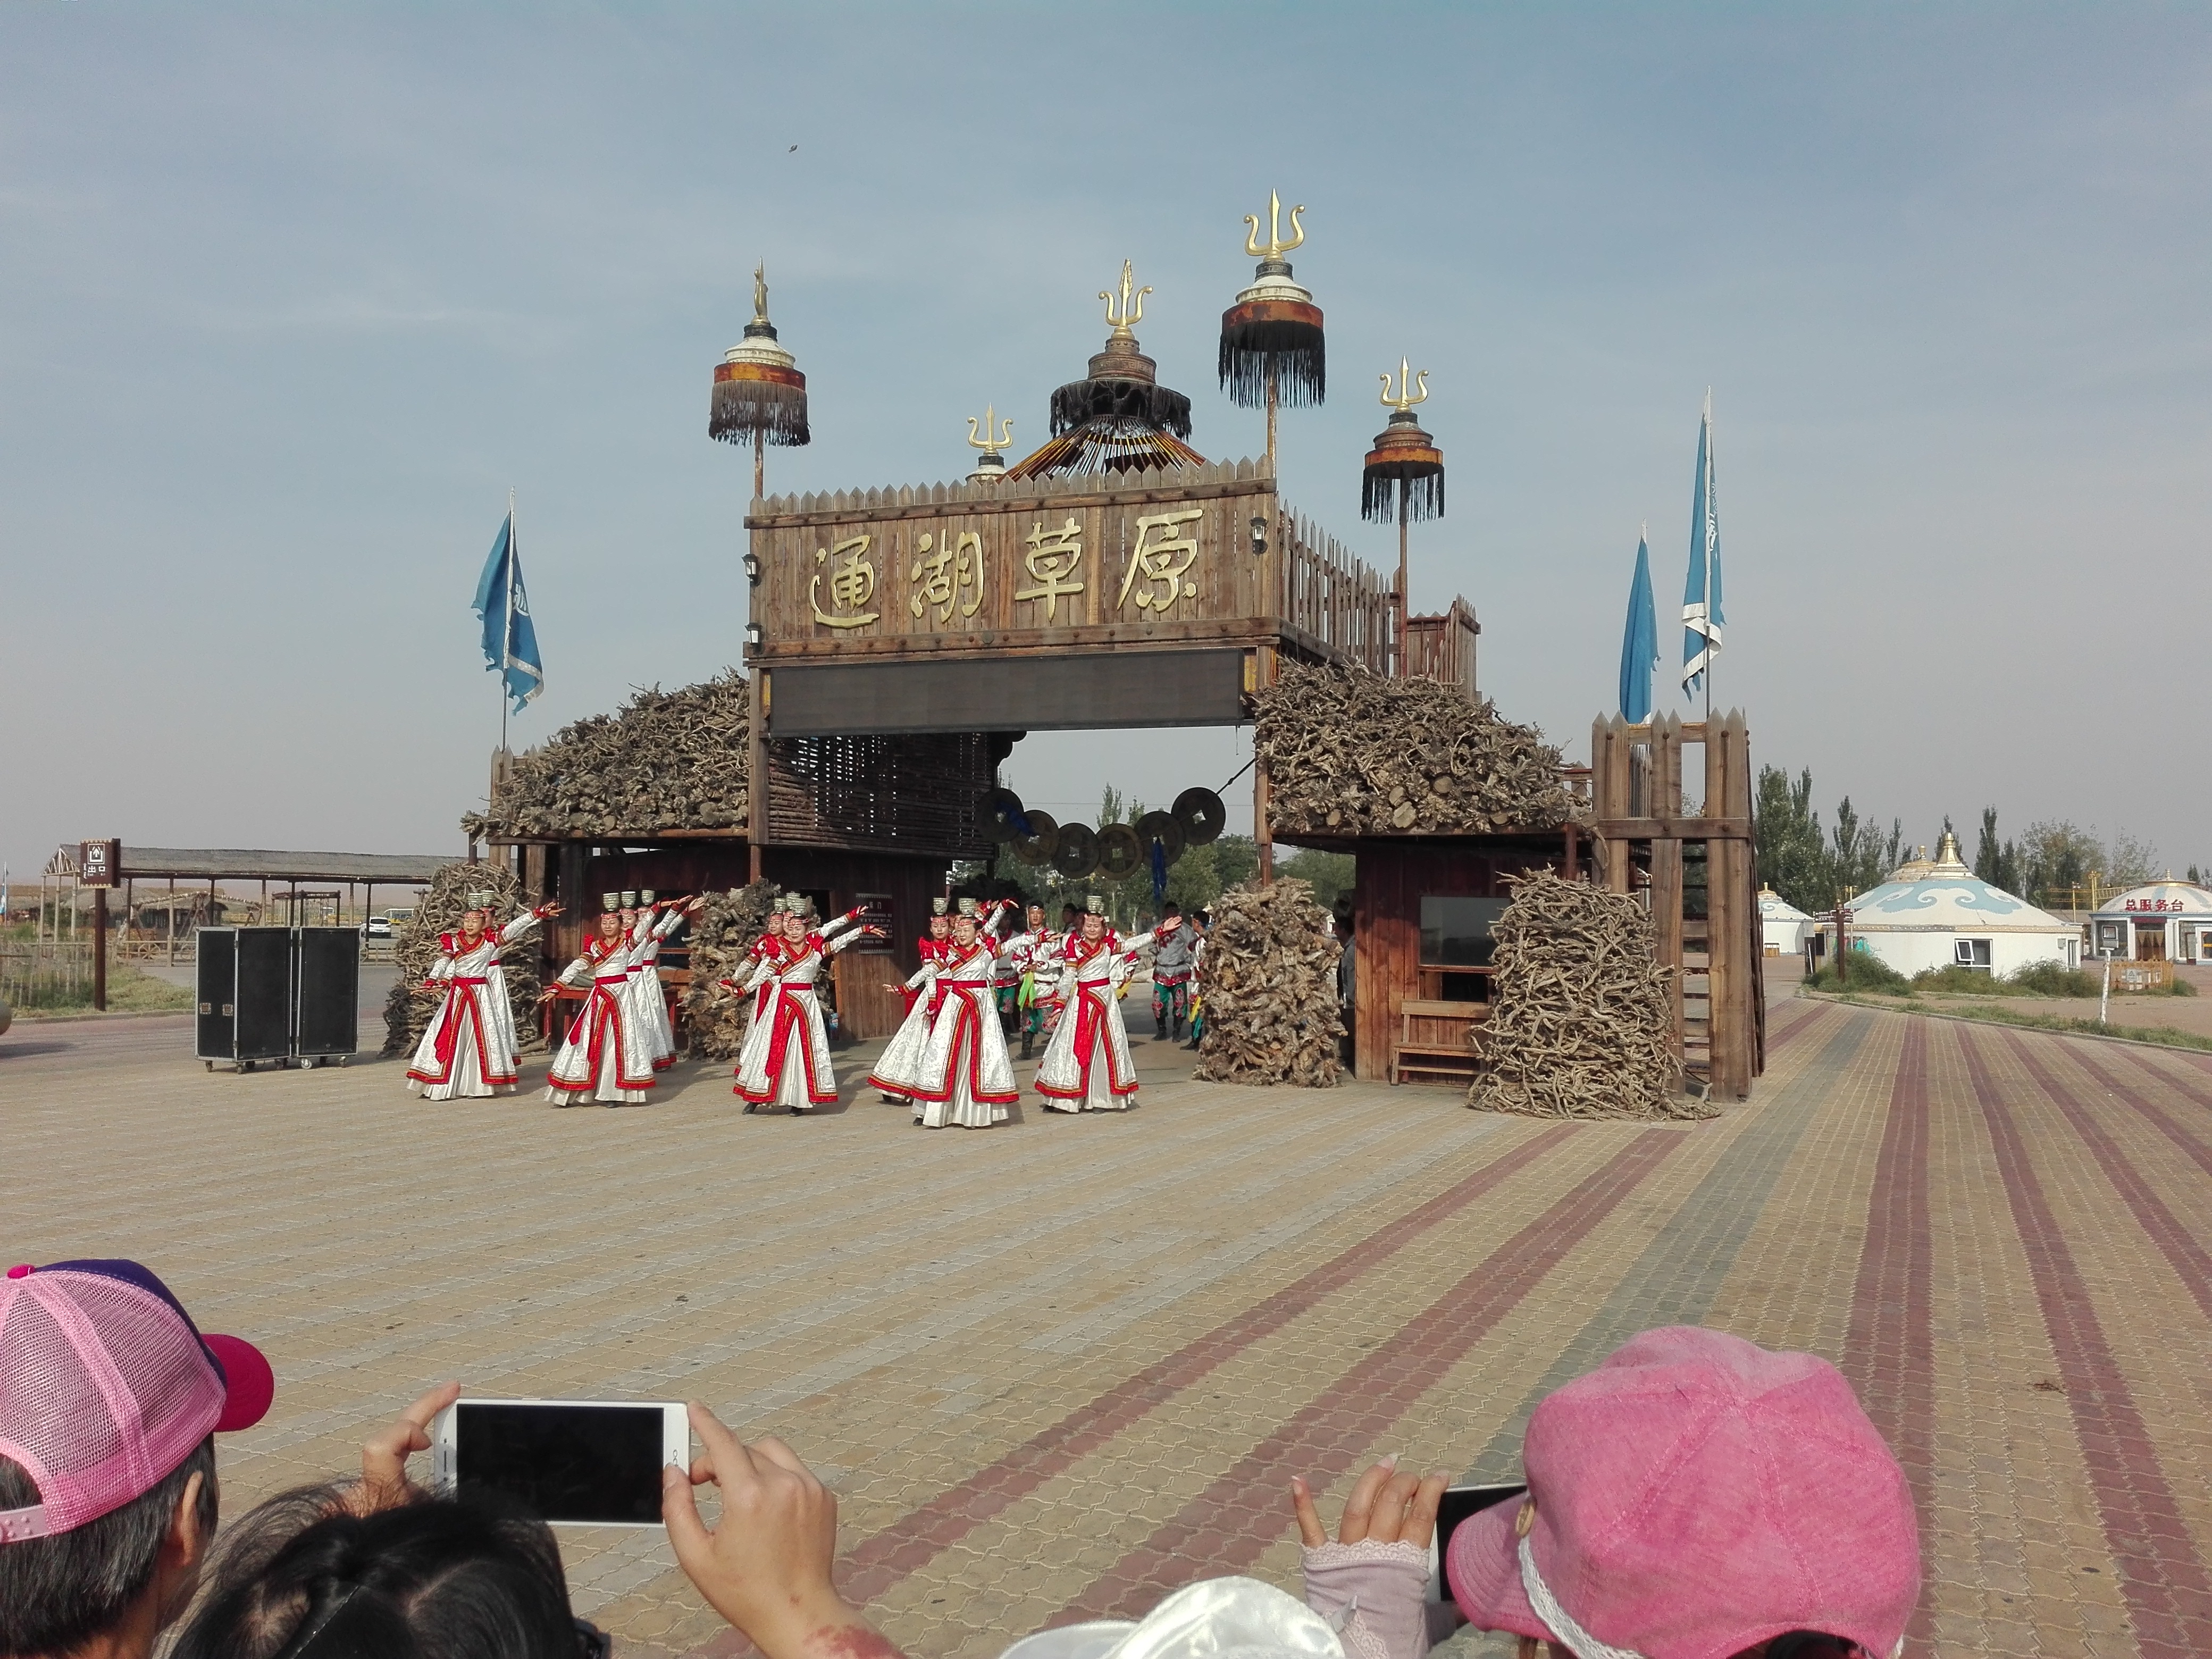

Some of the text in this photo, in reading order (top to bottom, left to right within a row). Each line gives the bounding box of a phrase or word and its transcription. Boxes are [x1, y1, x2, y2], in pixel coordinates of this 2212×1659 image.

[810, 509, 1204, 629] 通湖草原
[2125, 899, 2184, 911] 总服务台
